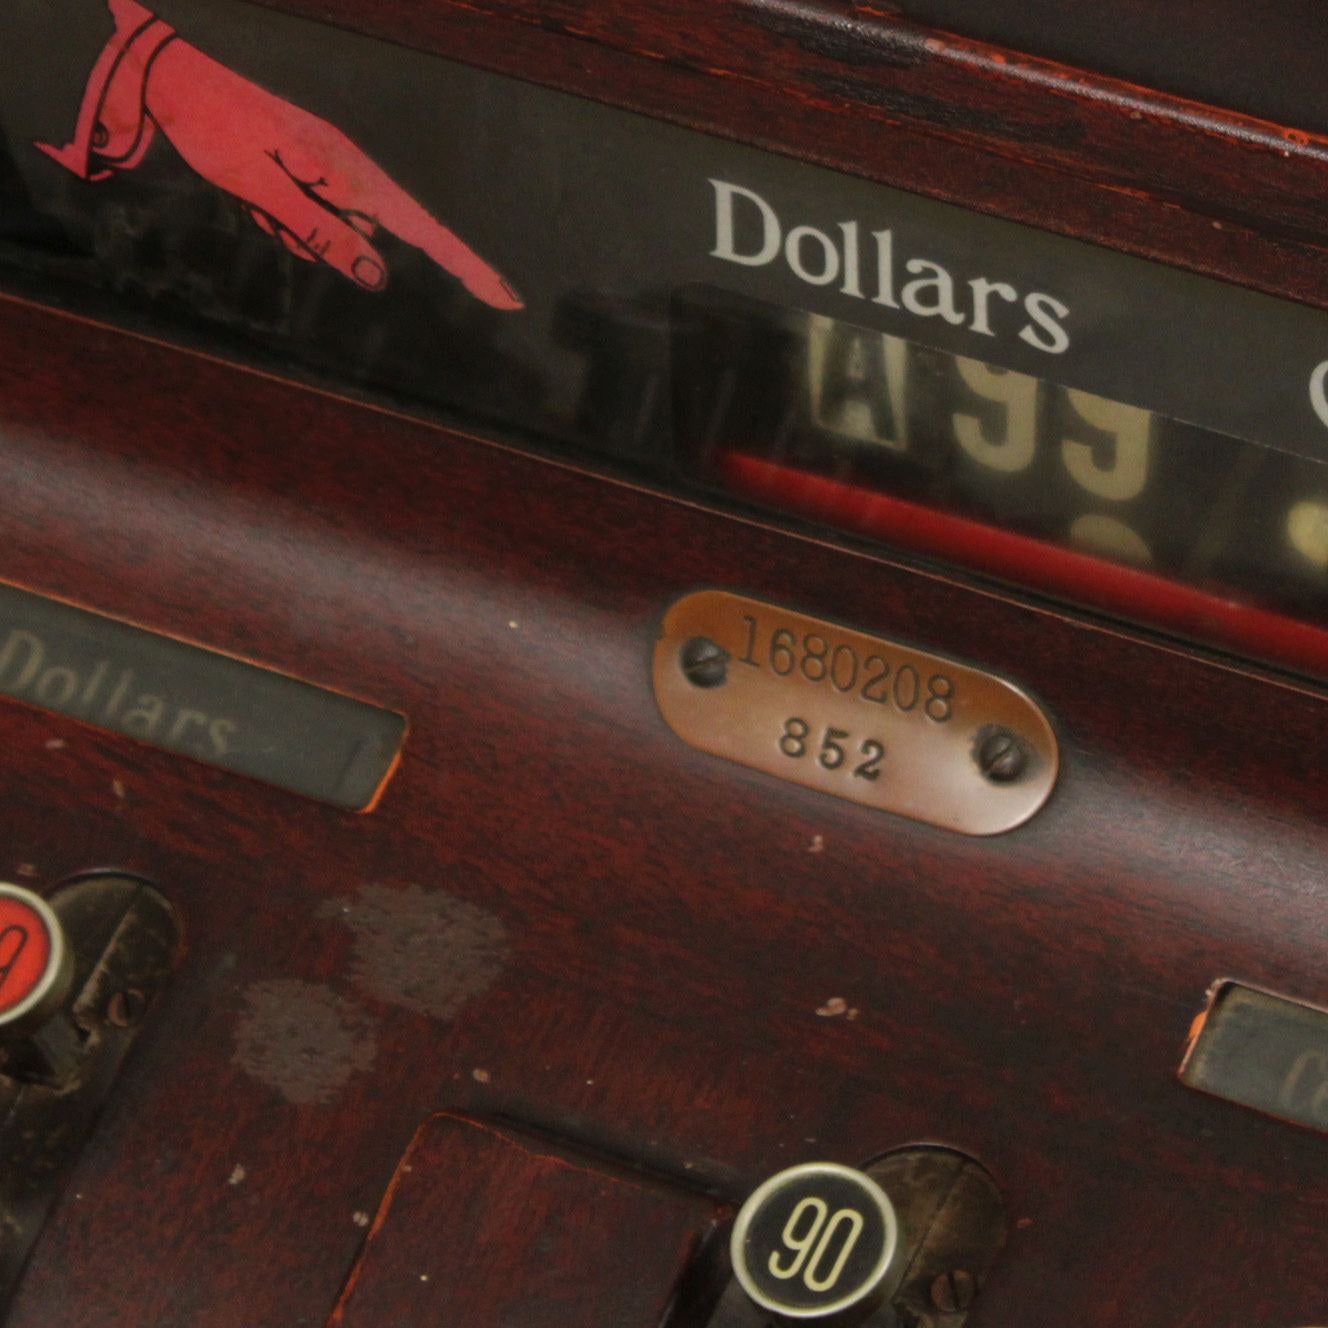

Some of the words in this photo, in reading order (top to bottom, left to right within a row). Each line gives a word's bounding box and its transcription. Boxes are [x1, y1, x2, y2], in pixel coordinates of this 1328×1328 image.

[707, 177, 1072, 355] Dollars
[737, 614, 957, 724] 1680208
[778, 716, 887, 782] 852
[768, 1196, 864, 1293] 90
